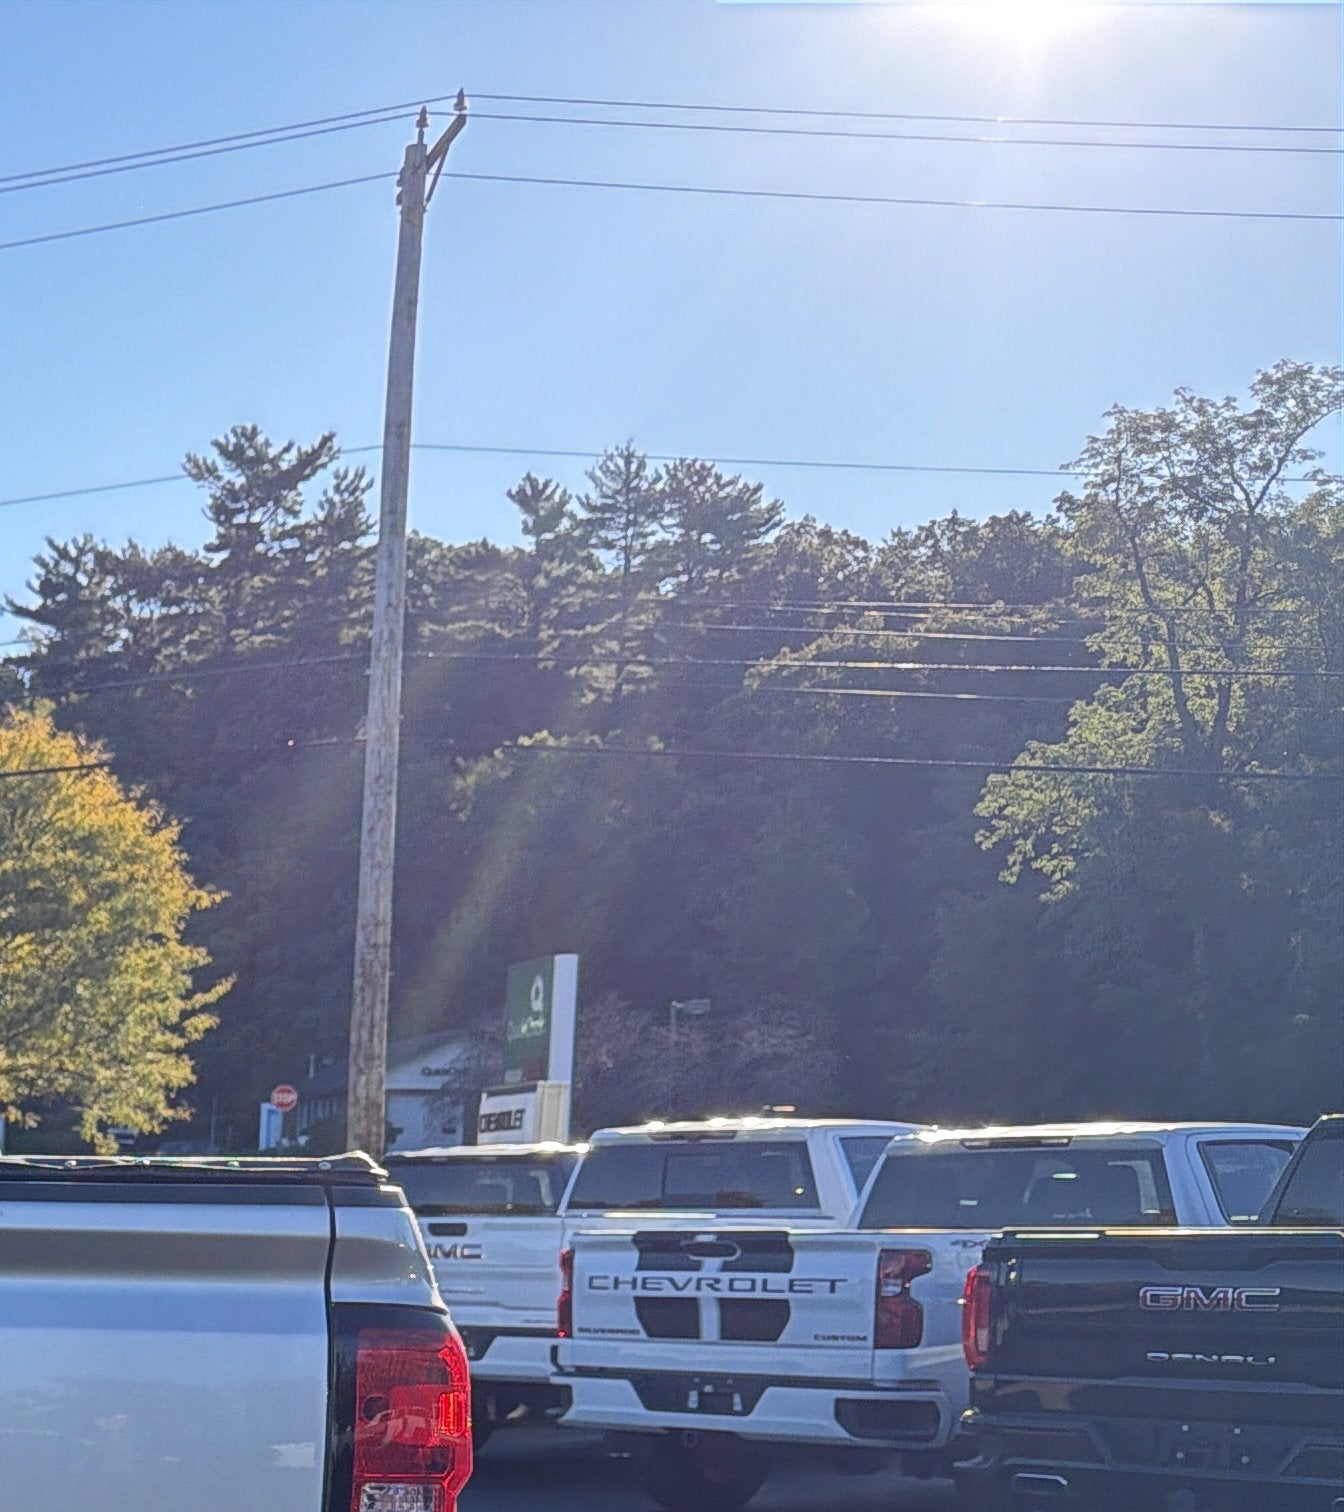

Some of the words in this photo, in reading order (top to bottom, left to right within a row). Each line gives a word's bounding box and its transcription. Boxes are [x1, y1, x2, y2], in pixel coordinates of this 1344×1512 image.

[425, 1243, 482, 1260] MC
[588, 1274, 847, 1294] CHEVROLET
[1139, 1286, 1280, 1312] GMC
[1146, 1351, 1276, 1365] DENALI
